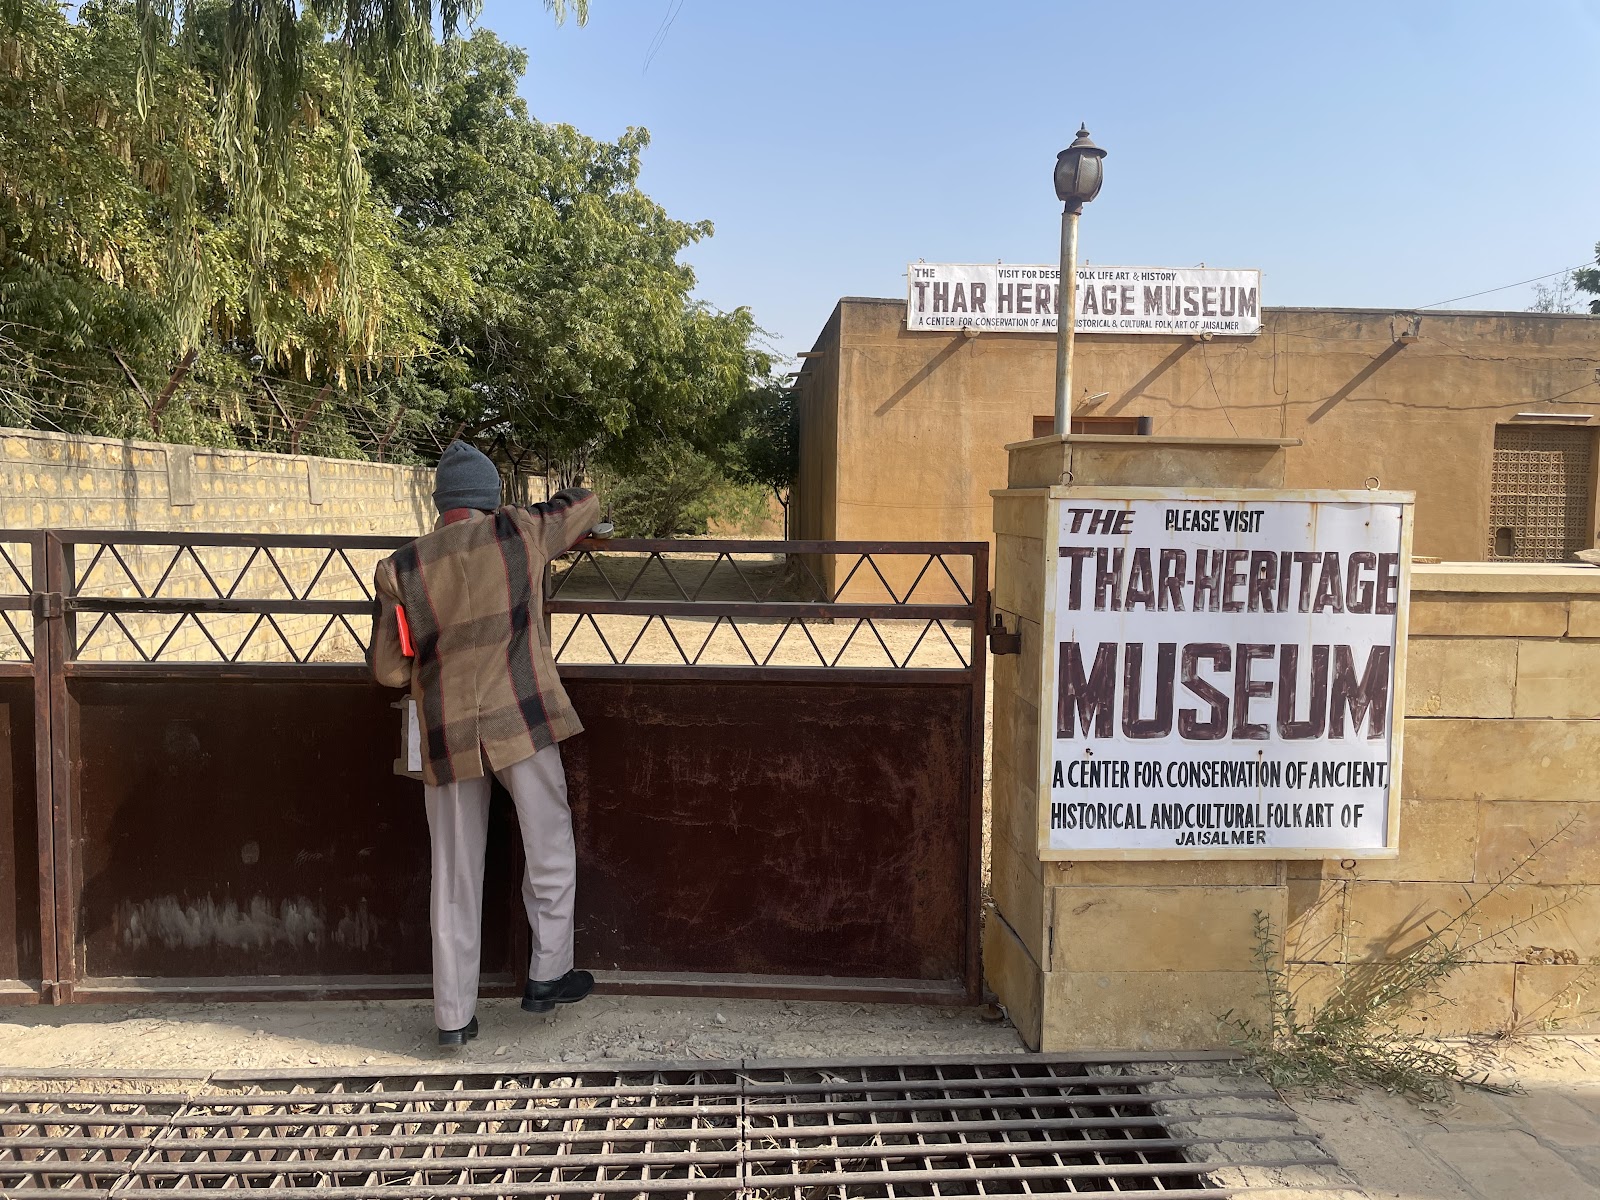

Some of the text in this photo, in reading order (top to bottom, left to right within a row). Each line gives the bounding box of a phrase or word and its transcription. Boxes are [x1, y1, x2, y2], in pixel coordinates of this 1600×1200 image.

[915, 269, 935, 278] THE
[999, 270, 1019, 278] VISIT
[1022, 270, 1037, 278] FOR
[1040, 270, 1061, 279] DESE
[1098, 272, 1113, 280] LIFE
[1116, 272, 1130, 280] ART
[1133, 272, 1140, 281] &
[1142, 272, 1176, 281] HISTORY
[915, 282, 1256, 318] THAR HERIAGE MUSEUM
[918, 317, 1239, 330] A CENTER FOR CONSERVATION OF ANCI ISTORICAL & CULTURAL FOLK ART OF JAISALMER
[1067, 508, 1264, 535] THE PLEASE VISIT
[1056, 642, 1390, 740] MUSEUM
[1052, 760, 1388, 790] A CENTER FOR CONSERVATION OF ANCIENT,
[1051, 803, 1146, 830] HISTORICAL
[1266, 803, 1302, 828] FOLK
[1304, 804, 1334, 828] ART
[1340, 804, 1364, 828] OF
[1176, 830, 1266, 846] JAISALMER
